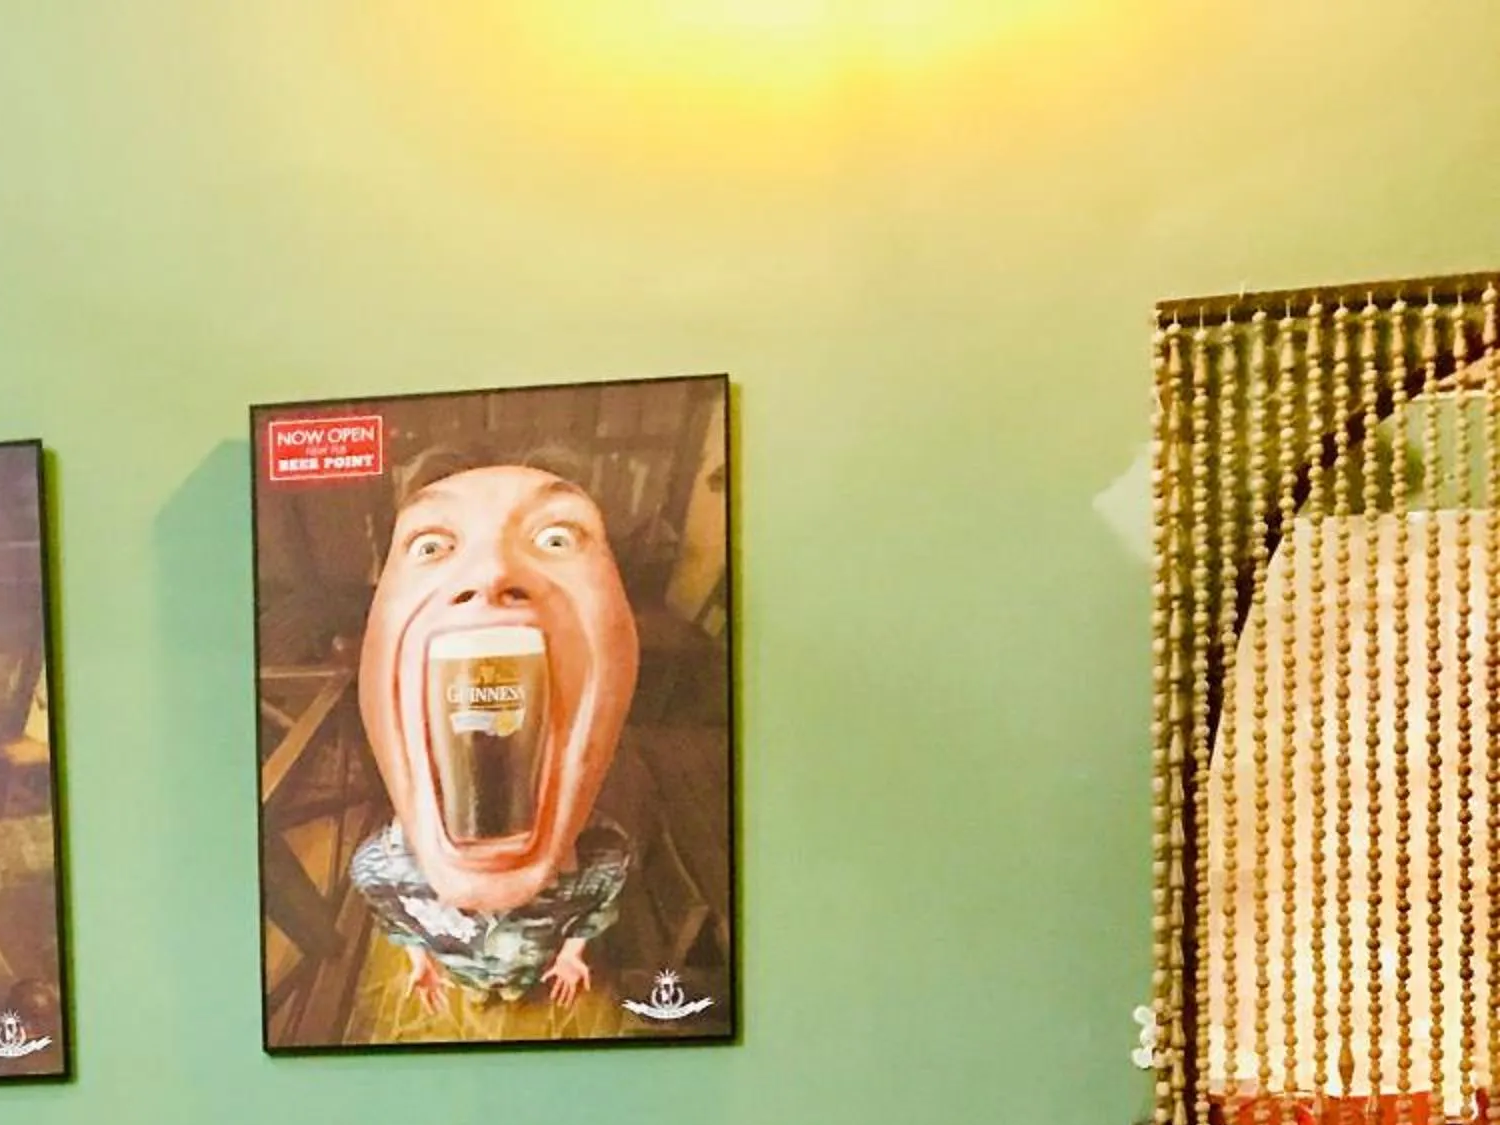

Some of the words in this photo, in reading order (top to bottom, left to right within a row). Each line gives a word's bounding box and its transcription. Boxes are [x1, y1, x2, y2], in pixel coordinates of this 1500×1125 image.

[277, 430, 324, 446] NOW
[328, 426, 374, 443] OPEN
[279, 458, 319, 472] BEER
[324, 455, 373, 468] POINT
